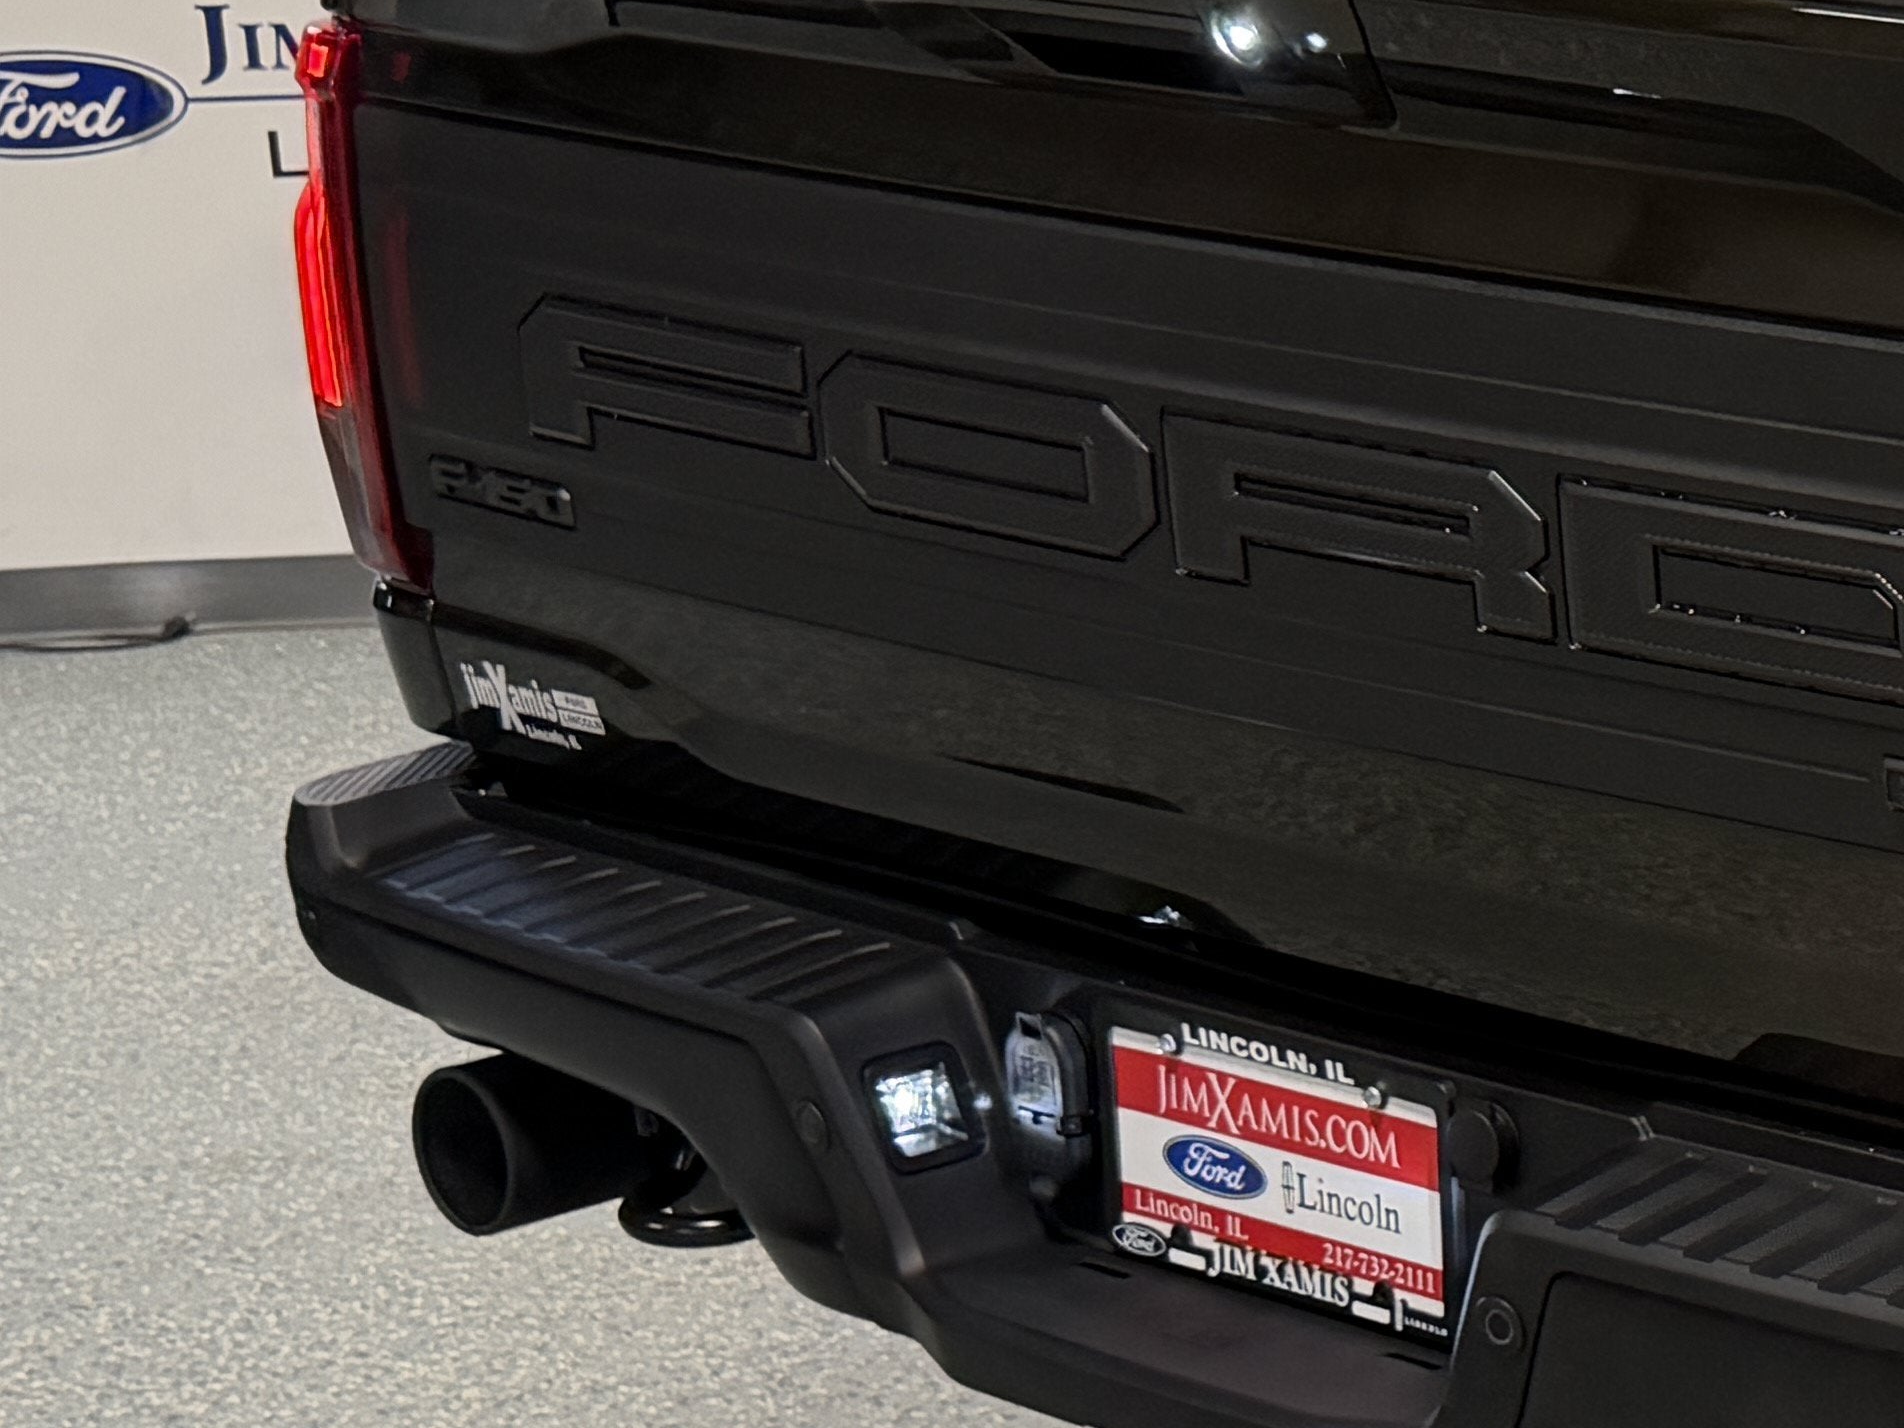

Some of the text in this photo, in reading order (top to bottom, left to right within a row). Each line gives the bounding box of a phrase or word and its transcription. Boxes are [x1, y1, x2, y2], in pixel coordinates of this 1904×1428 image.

[1180, 1022, 1355, 1086] LINCOLN, IL
[1156, 1063, 1402, 1170] JIMXAMIS.COM
[1182, 1141, 1247, 1191] Ford
[1226, 1214, 1250, 1241] IL
[1296, 1171, 1402, 1235] Lincoln
[1207, 1236, 1257, 1278] JIM
[1322, 1242, 1437, 1294] 217-732-2111
